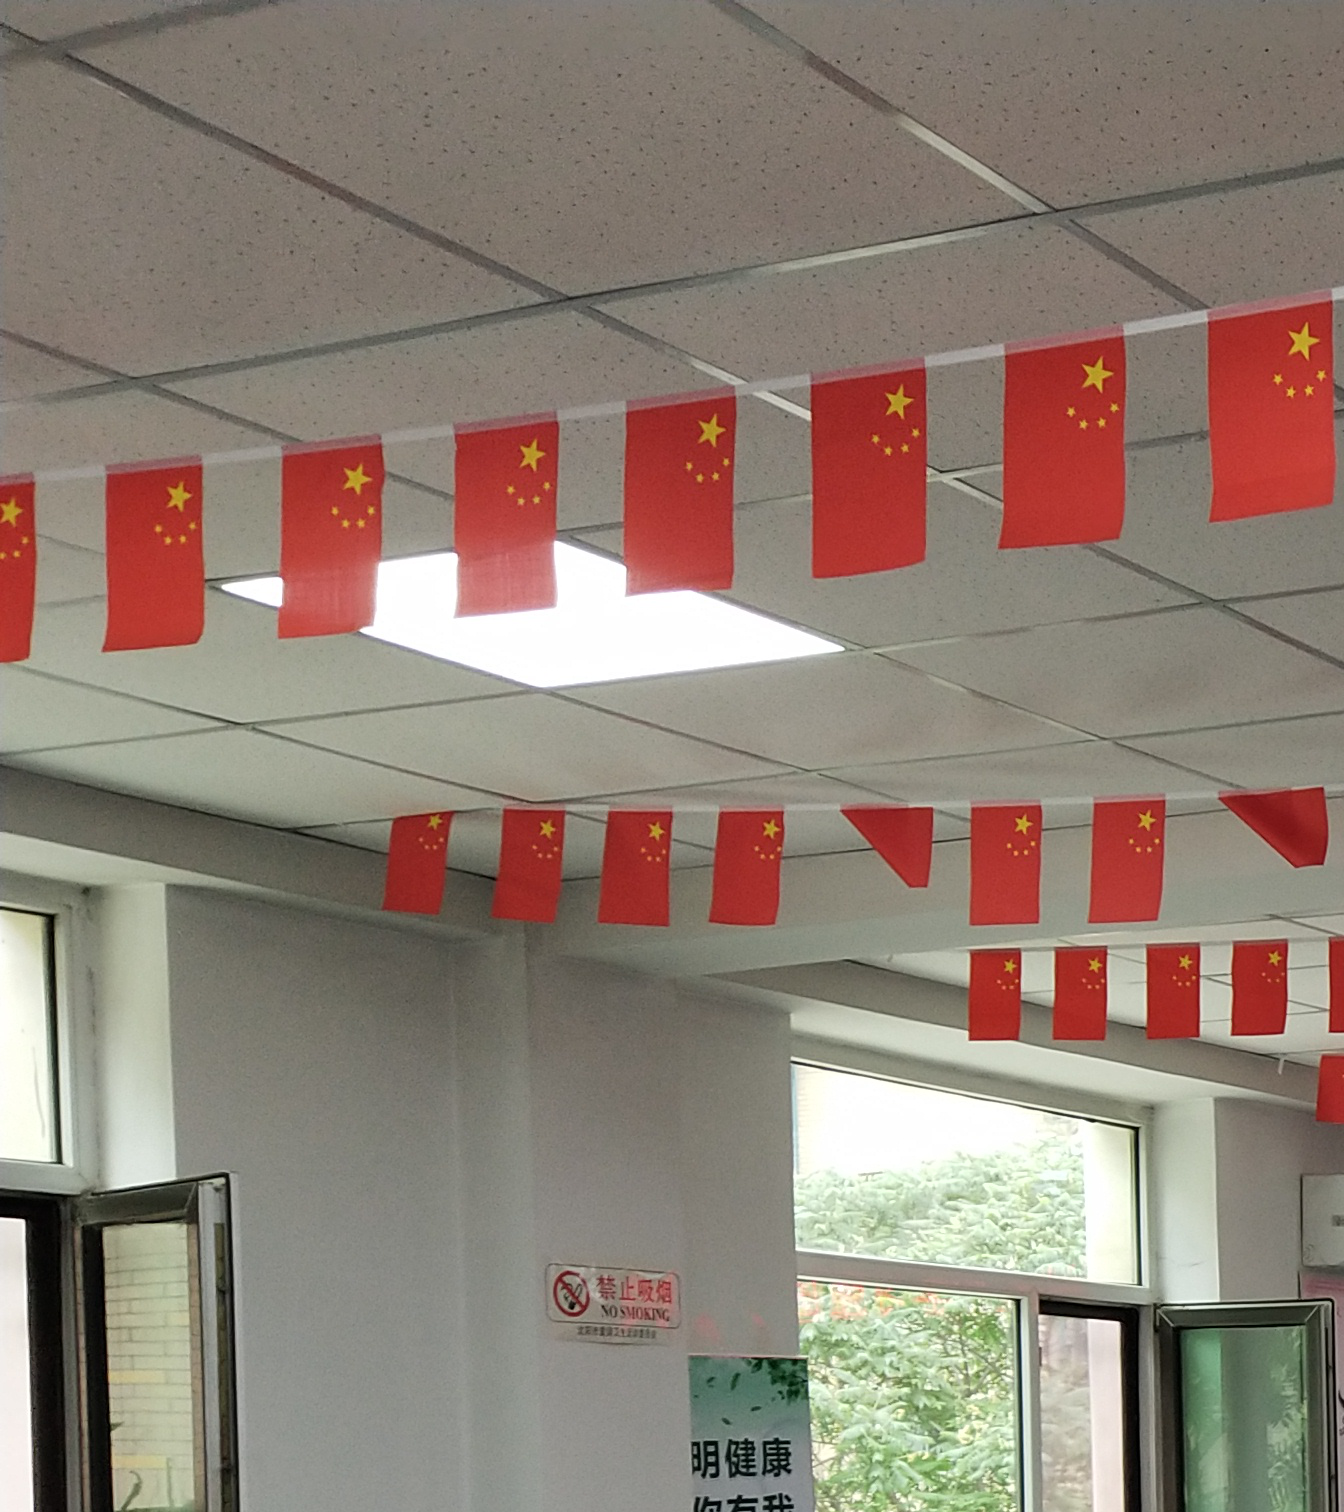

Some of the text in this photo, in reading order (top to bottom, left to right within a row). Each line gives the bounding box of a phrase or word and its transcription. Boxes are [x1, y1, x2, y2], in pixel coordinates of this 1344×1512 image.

[596, 1274, 672, 1304] 禁止吸烟
[601, 1304, 670, 1321] NO SMOKING
[691, 1437, 792, 1479] 明健康
